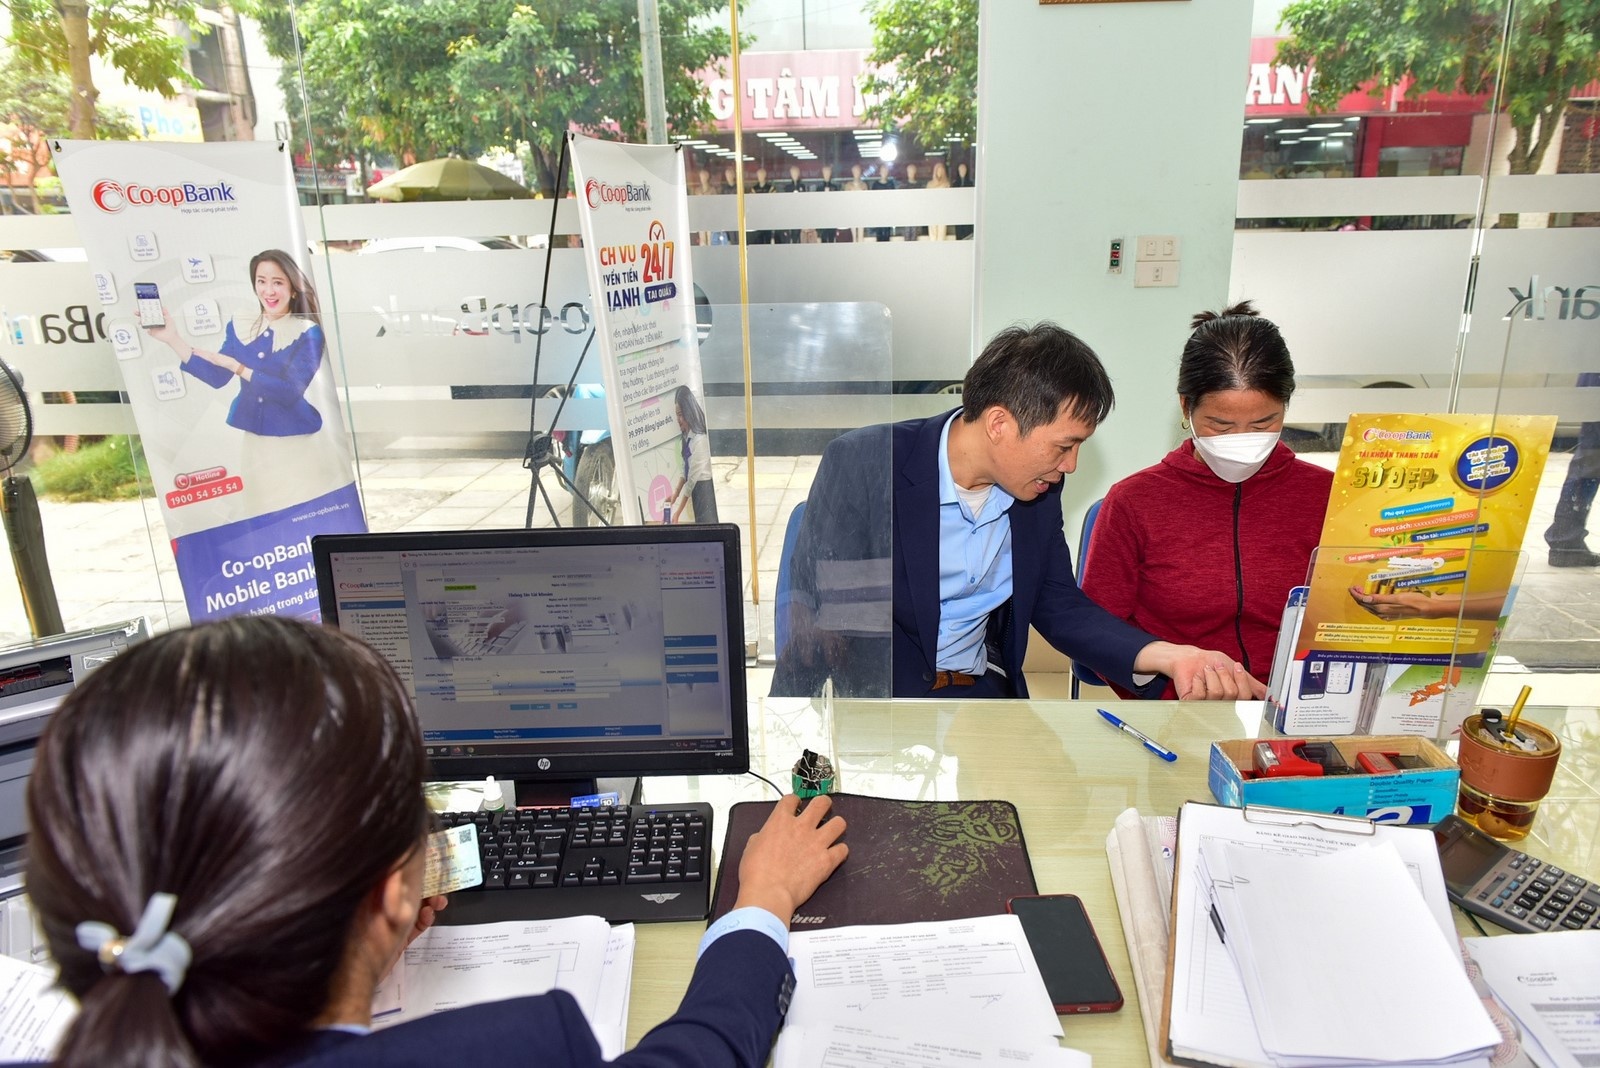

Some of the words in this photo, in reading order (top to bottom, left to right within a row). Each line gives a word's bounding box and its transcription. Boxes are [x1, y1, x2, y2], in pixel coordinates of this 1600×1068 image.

[747, 68, 840, 119] TÂM
[641, 242, 674, 283] 24/7
[1395, 451, 1419, 459] THANH
[195, 471, 221, 483] Hotline
[1353, 459, 1385, 489] SỐ
[1388, 466, 1436, 493] ĐẸP
[171, 494, 193, 506] 1900
[196, 489, 208, 500] 54
[211, 486, 223, 496] 55
[225, 481, 238, 492] 54
[291, 503, 350, 523] www.co-opbank.vn
[205, 579, 272, 614] Mobile
[277, 594, 303, 610] trong
